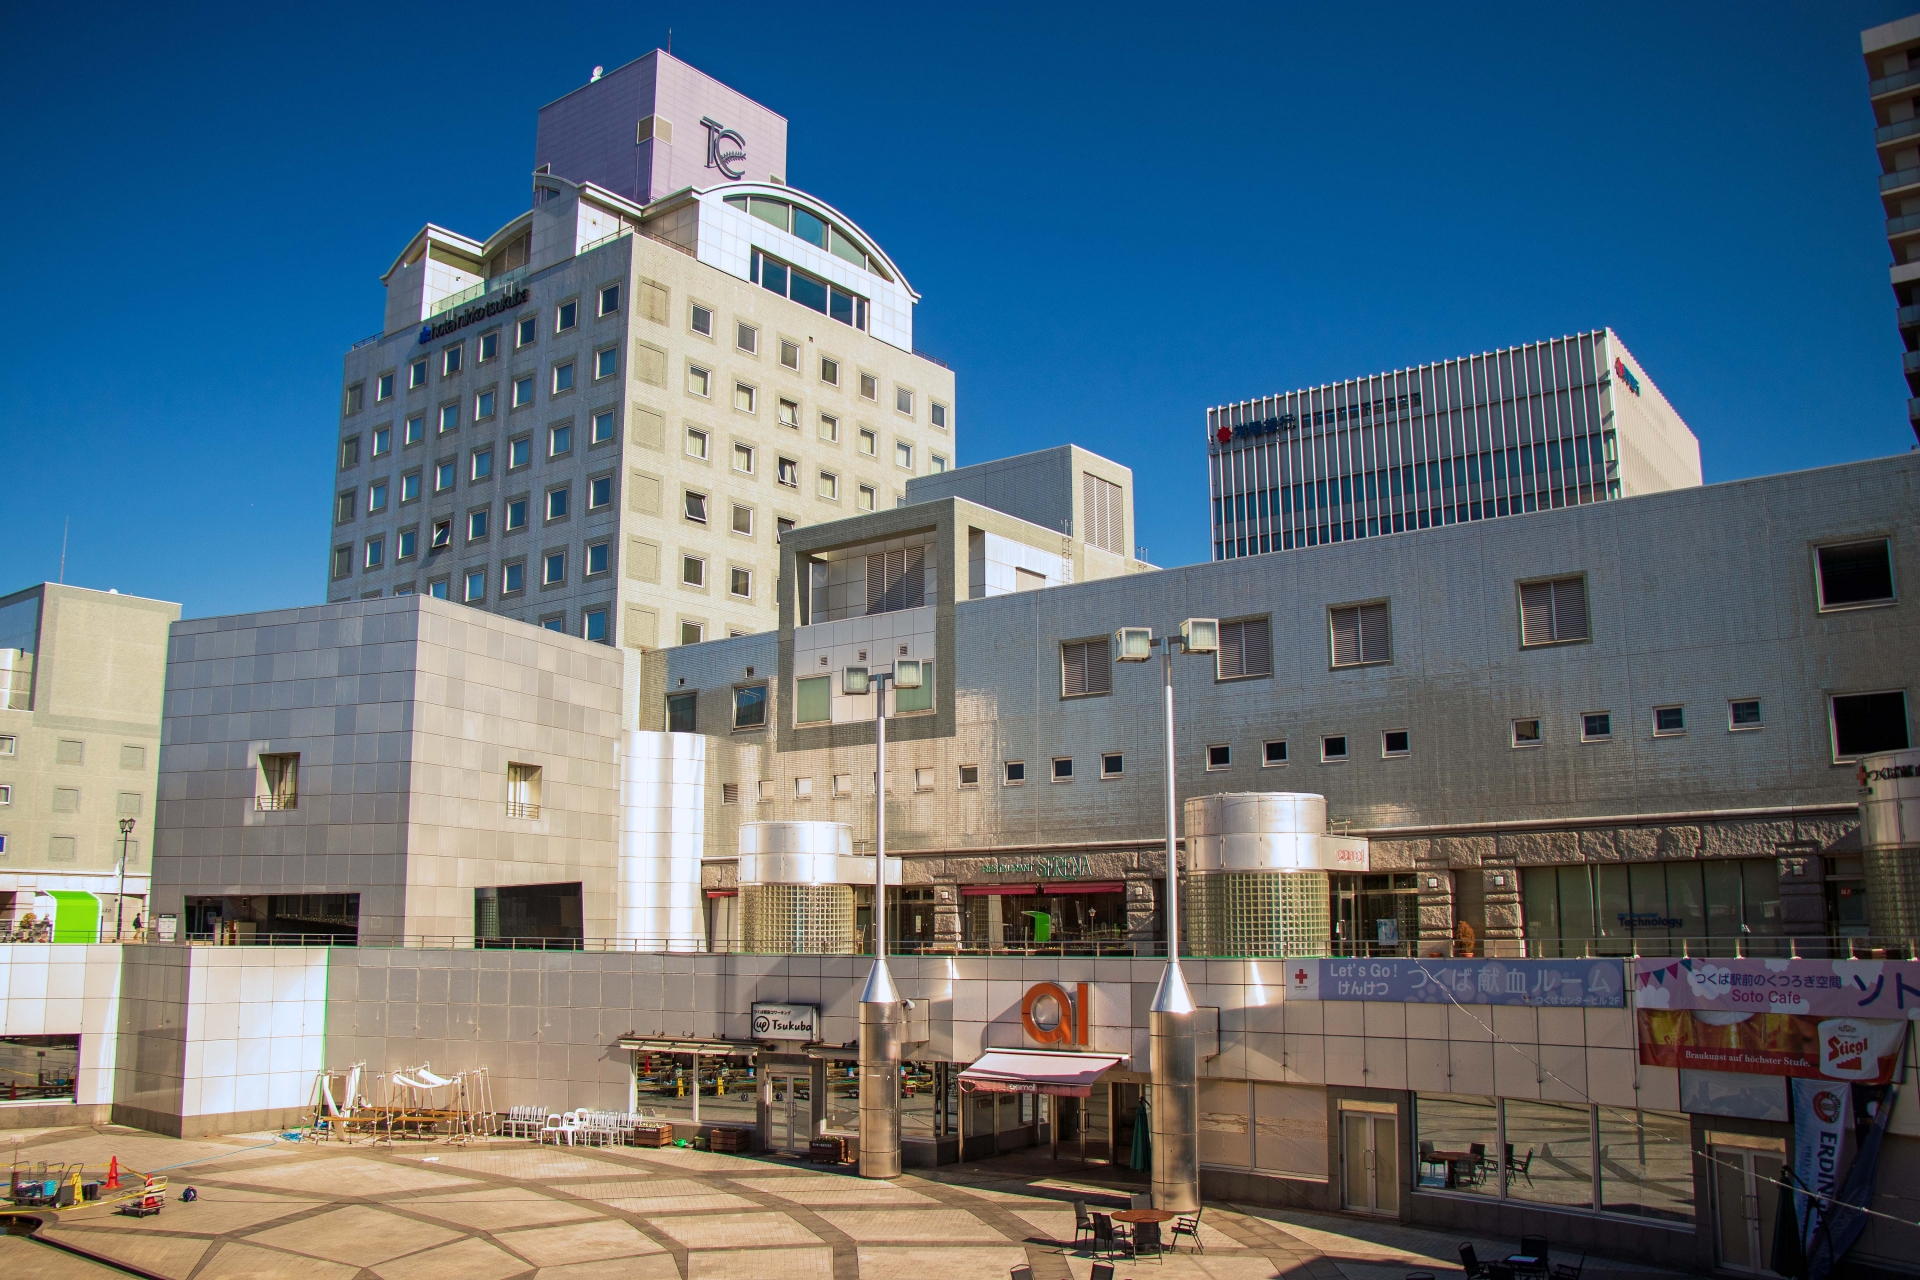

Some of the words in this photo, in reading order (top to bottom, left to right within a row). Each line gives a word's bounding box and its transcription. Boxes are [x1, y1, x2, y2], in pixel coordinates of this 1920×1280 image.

[430, 313, 458, 340] hotel
[457, 305, 485, 330] nikko
[485, 287, 532, 318] tsukuba
[1036, 855, 1092, 880] SERENA
[1618, 917, 1683, 928] Technology
[1330, 963, 1366, 977] Let's
[1407, 967, 1611, 994] つくば献血ルーム
[1695, 972, 1842, 989] つくば駅前のくつろぎ空間
[1338, 981, 1389, 996] けんけつ
[1536, 996, 1607, 1006] つくばセンタービル
[1609, 997, 1621, 1006] 2F
[1731, 989, 1764, 1003] Soto
[1768, 990, 1800, 1004] Cafe
[772, 1020, 812, 1031] Tsukuba
[1828, 1036, 1868, 1062] Stiegl
[1685, 1051, 1727, 1061] Braukunst
[1728, 1053, 1743, 1062] auf
[1745, 1053, 1782, 1065] höchster
[1784, 1057, 1811, 1067] Stufe.
